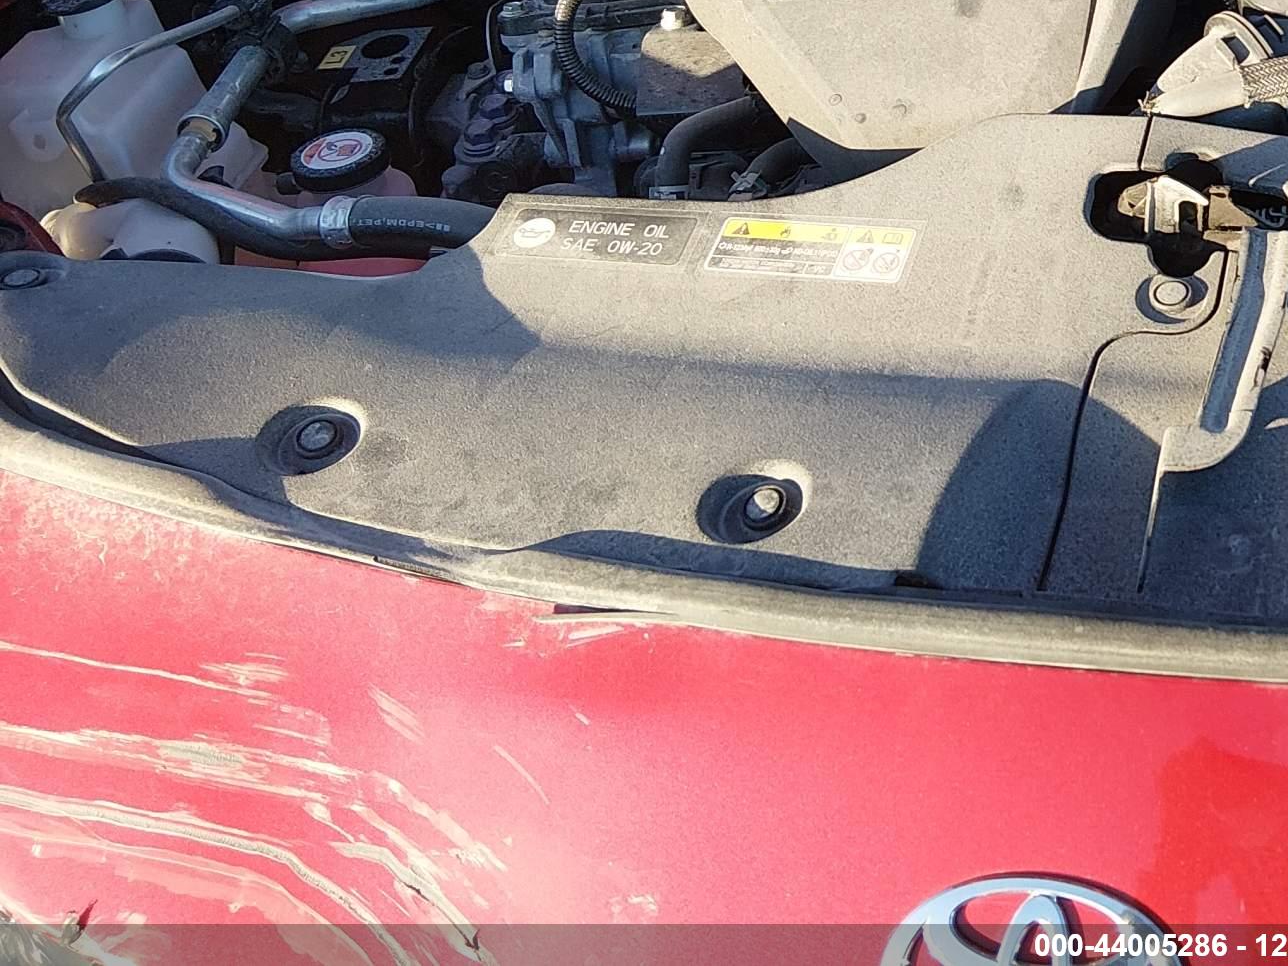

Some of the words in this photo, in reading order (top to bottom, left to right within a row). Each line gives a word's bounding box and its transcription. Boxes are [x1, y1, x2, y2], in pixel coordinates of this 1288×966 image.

[568, 220, 636, 237] ENGINE
[643, 224, 670, 239] OIL
[560, 237, 599, 252] SAE
[607, 240, 663, 256] 0W-20
